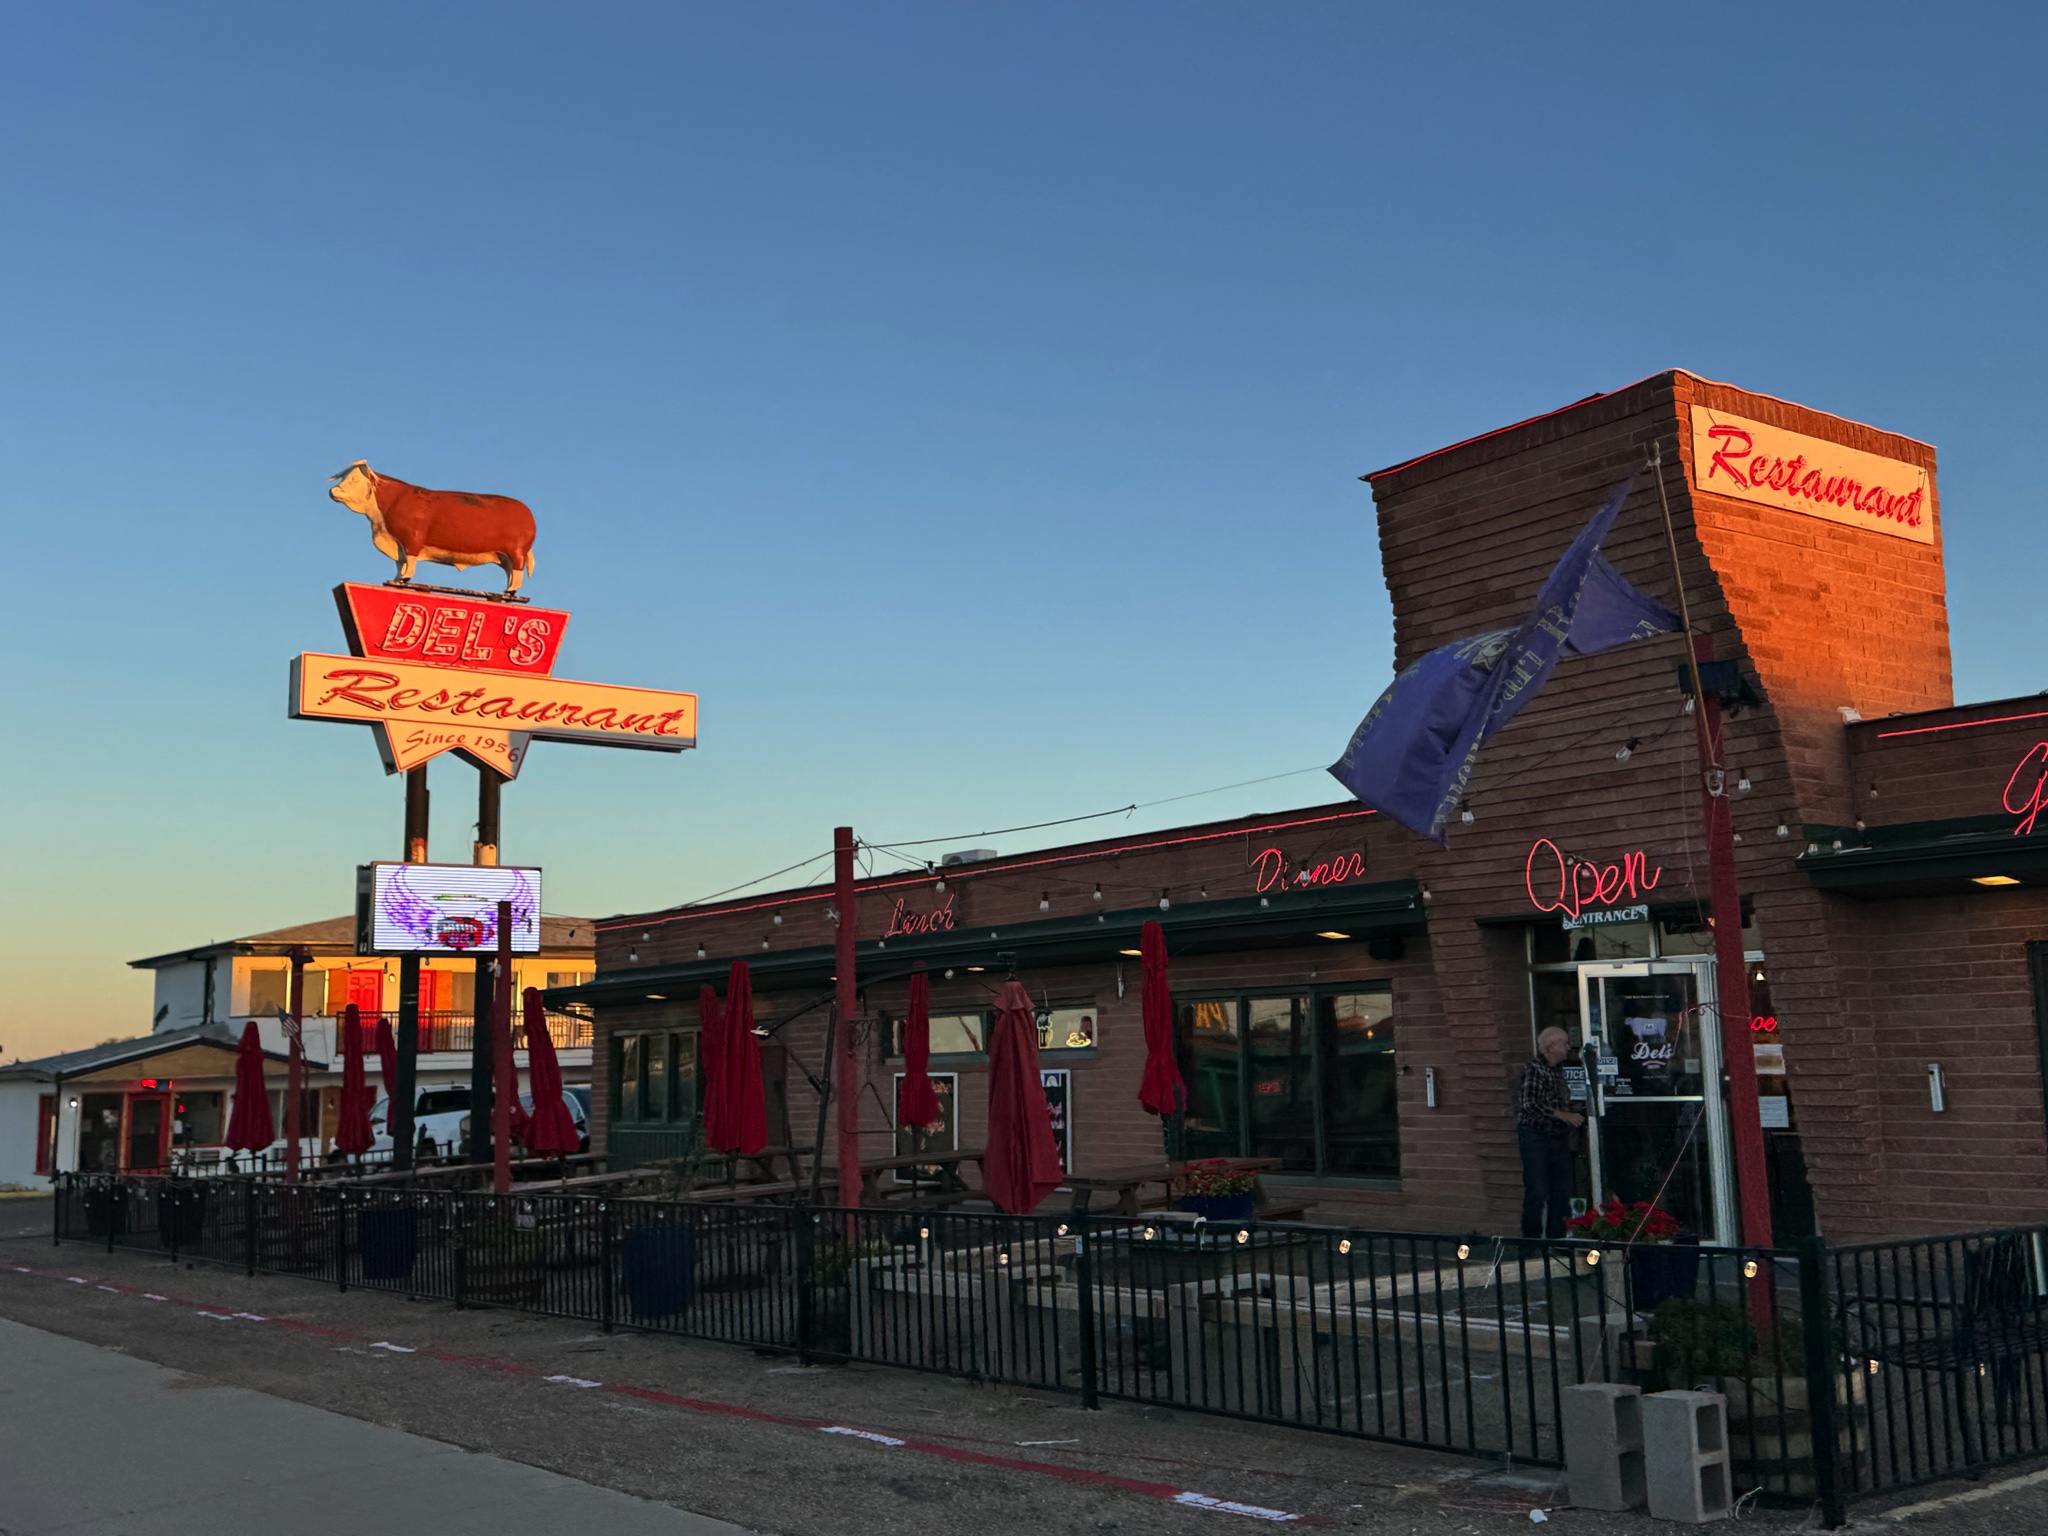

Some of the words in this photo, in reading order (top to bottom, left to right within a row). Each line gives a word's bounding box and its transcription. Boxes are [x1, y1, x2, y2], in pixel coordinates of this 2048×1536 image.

[1708, 424, 1925, 528] Restaurant
[381, 603, 550, 666] DEL'S
[318, 669, 685, 735] Restaurant
[401, 730, 466, 754] Since
[474, 735, 520, 763] 1956
[1525, 837, 1661, 918] Open
[1572, 908, 1640, 925] ENTRANCE
[1564, 1070, 1585, 1079] TICE
[1631, 1042, 1673, 1059] Del's
